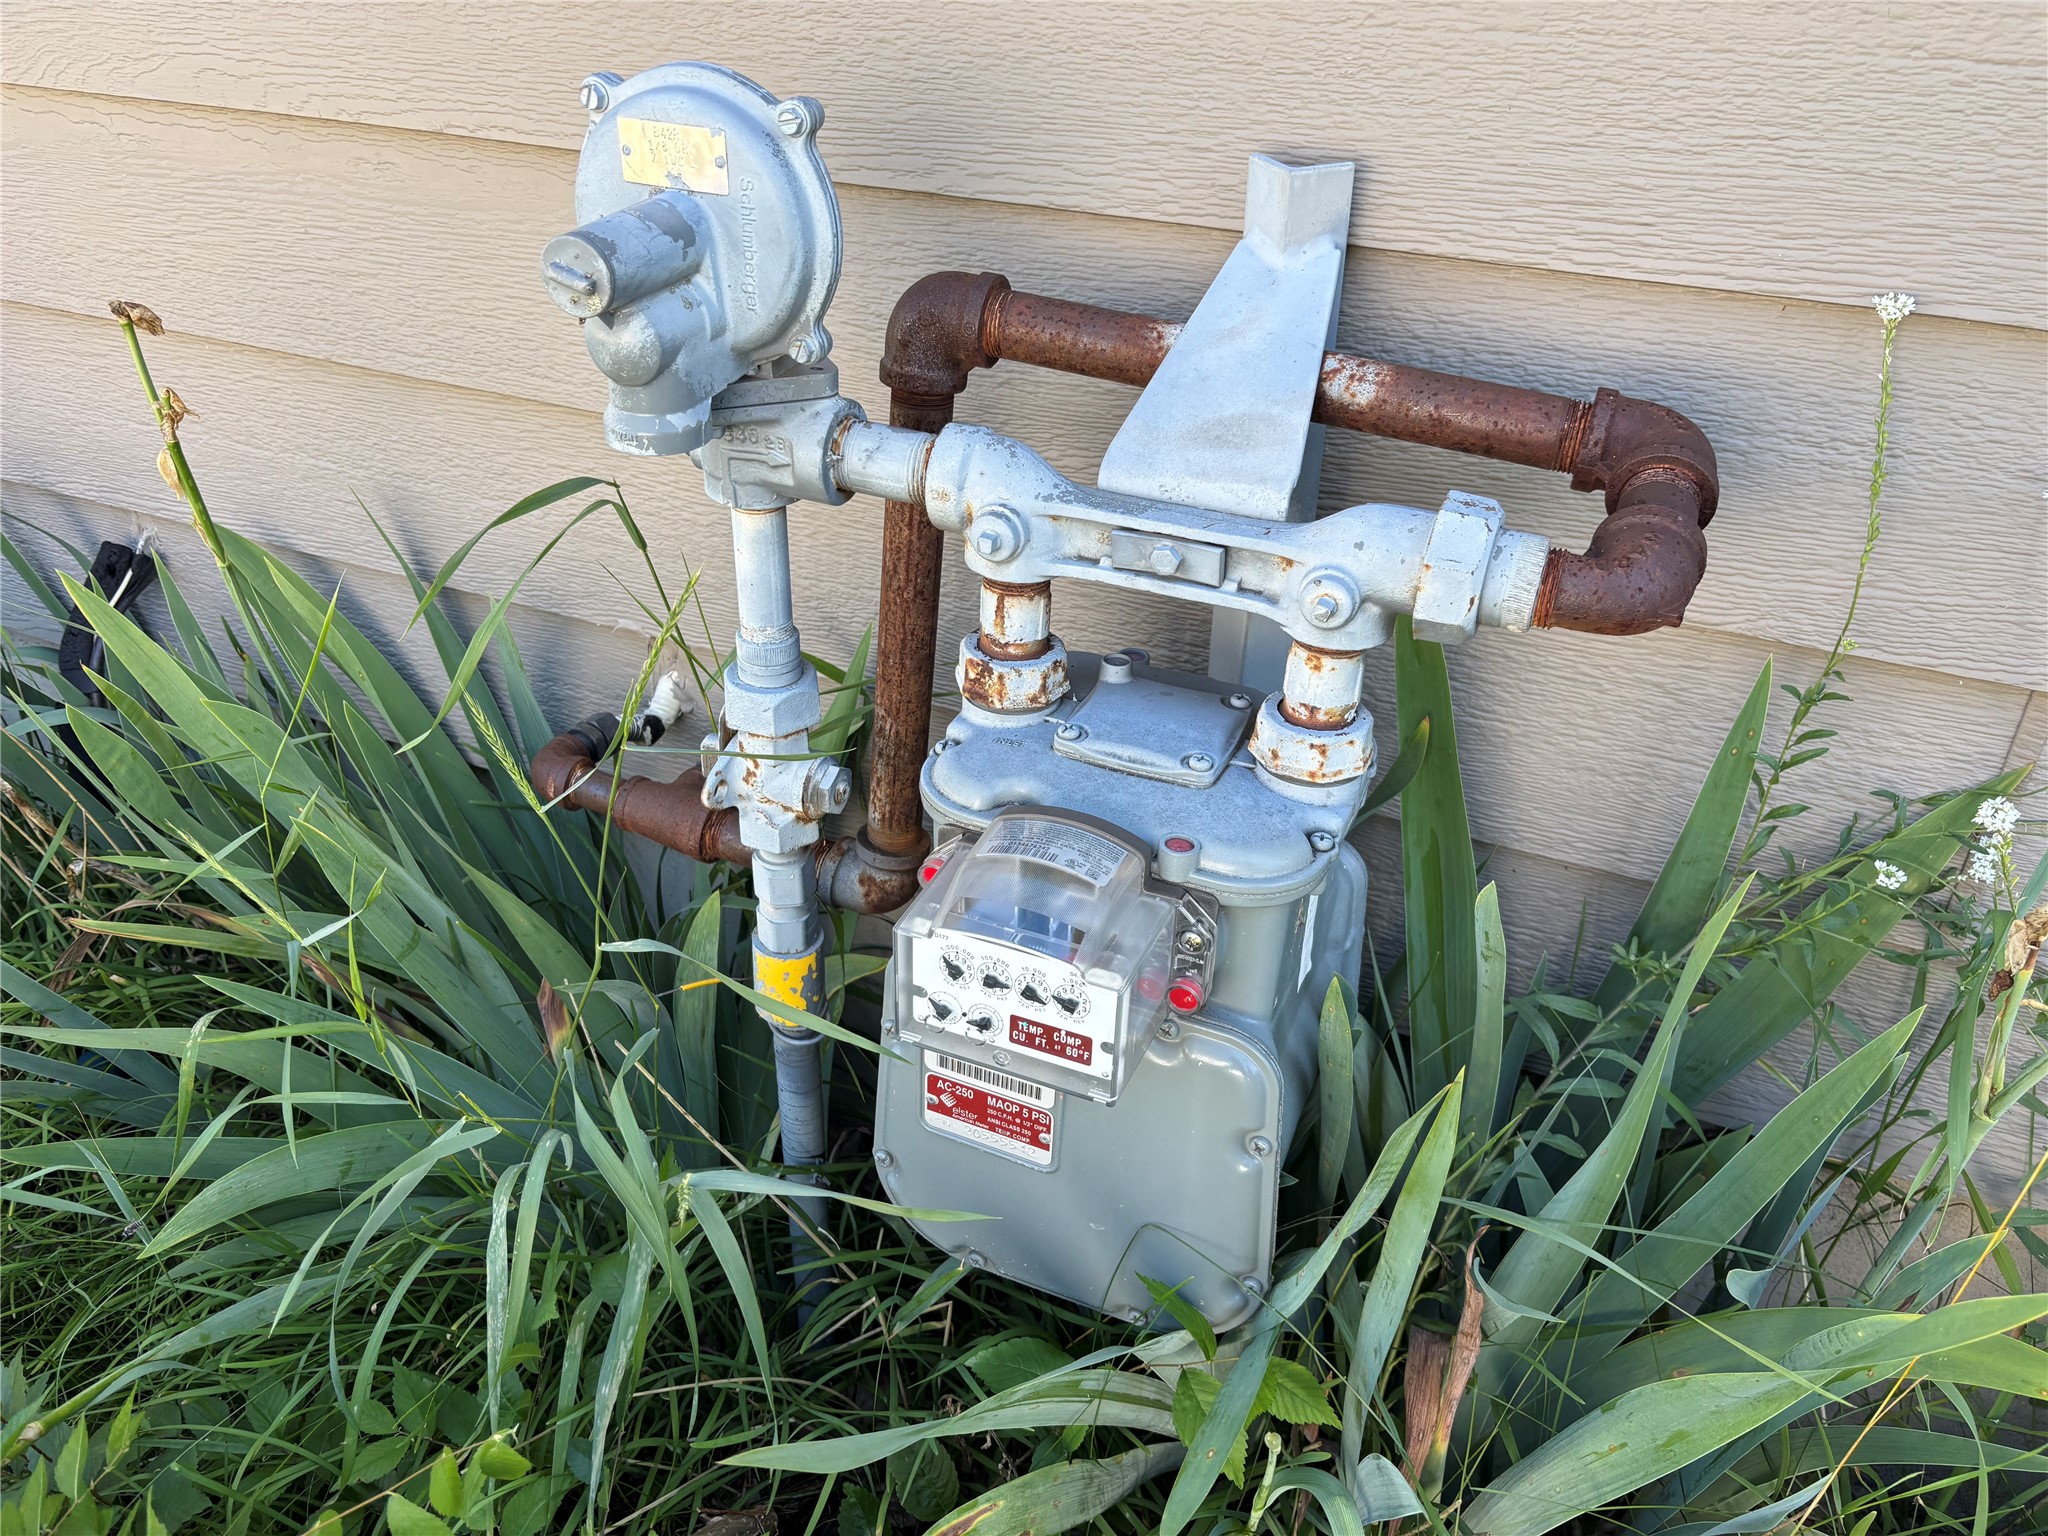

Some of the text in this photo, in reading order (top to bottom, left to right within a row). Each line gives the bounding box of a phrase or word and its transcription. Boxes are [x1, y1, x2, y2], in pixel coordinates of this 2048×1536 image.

[738, 176, 759, 316] Schlumberger
[1017, 1021, 1046, 1038] TEMP.
[1053, 1030, 1084, 1049] COMP.
[1012, 1030, 1028, 1043] CU.
[1035, 1037, 1050, 1049] FT.
[1066, 1046, 1090, 1060] 60°F
[936, 1080, 974, 1099] AC-250
[952, 1106, 978, 1120] elster
[986, 1108, 997, 1116] 250
[987, 1095, 1050, 1125] MAOP 5 PSI
[952, 1113, 975, 1124] American
[975, 1120, 989, 1129] Meter
[986, 1117, 1032, 1136] ANSI CLASS 250
